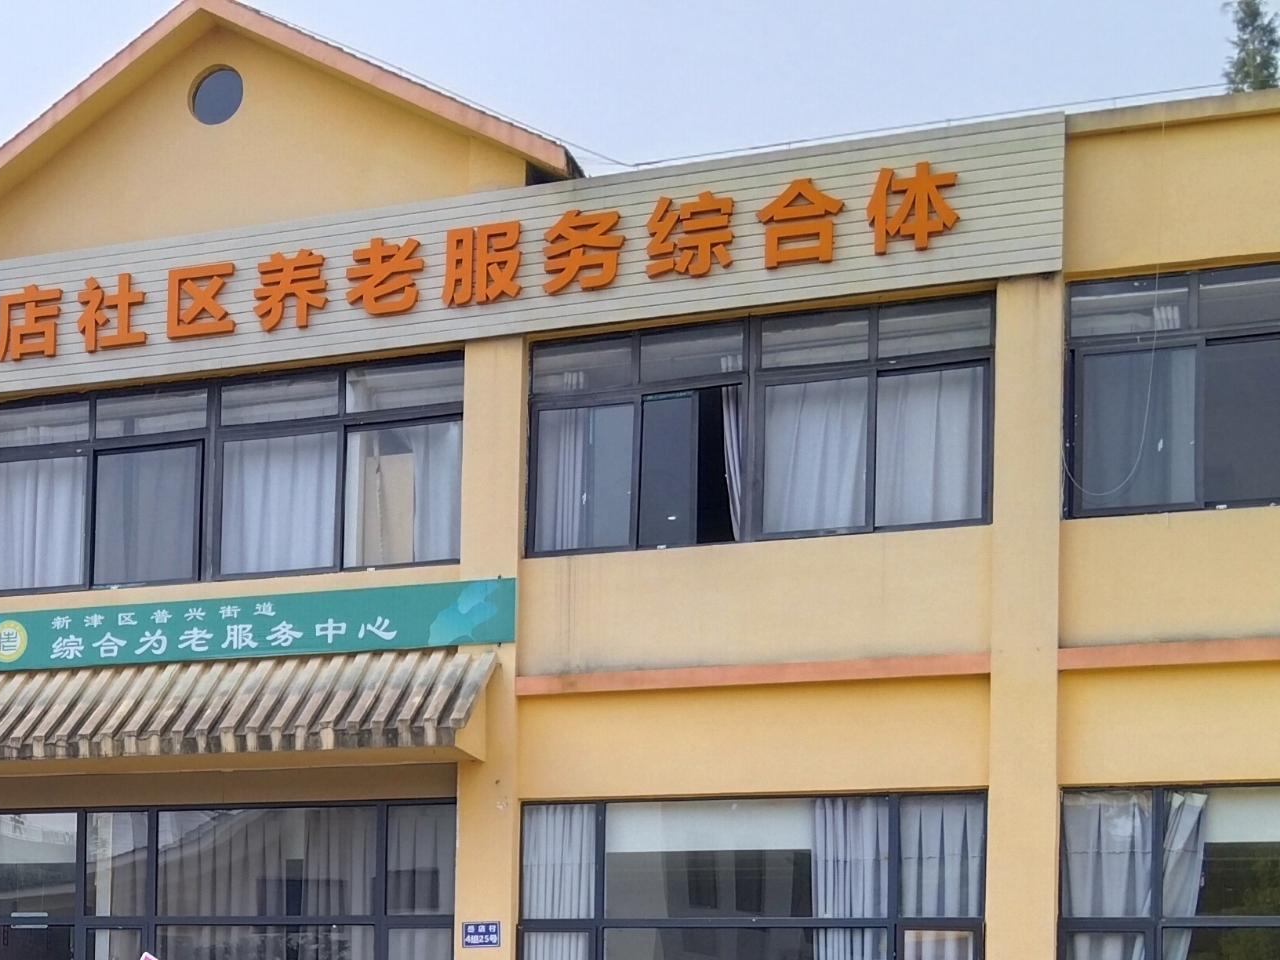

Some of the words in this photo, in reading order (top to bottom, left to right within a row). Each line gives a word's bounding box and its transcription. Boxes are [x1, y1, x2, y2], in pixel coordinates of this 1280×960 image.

[51, 601, 277, 630] 新津区普兴街道
[49, 616, 398, 659] 综合为老服务中心
